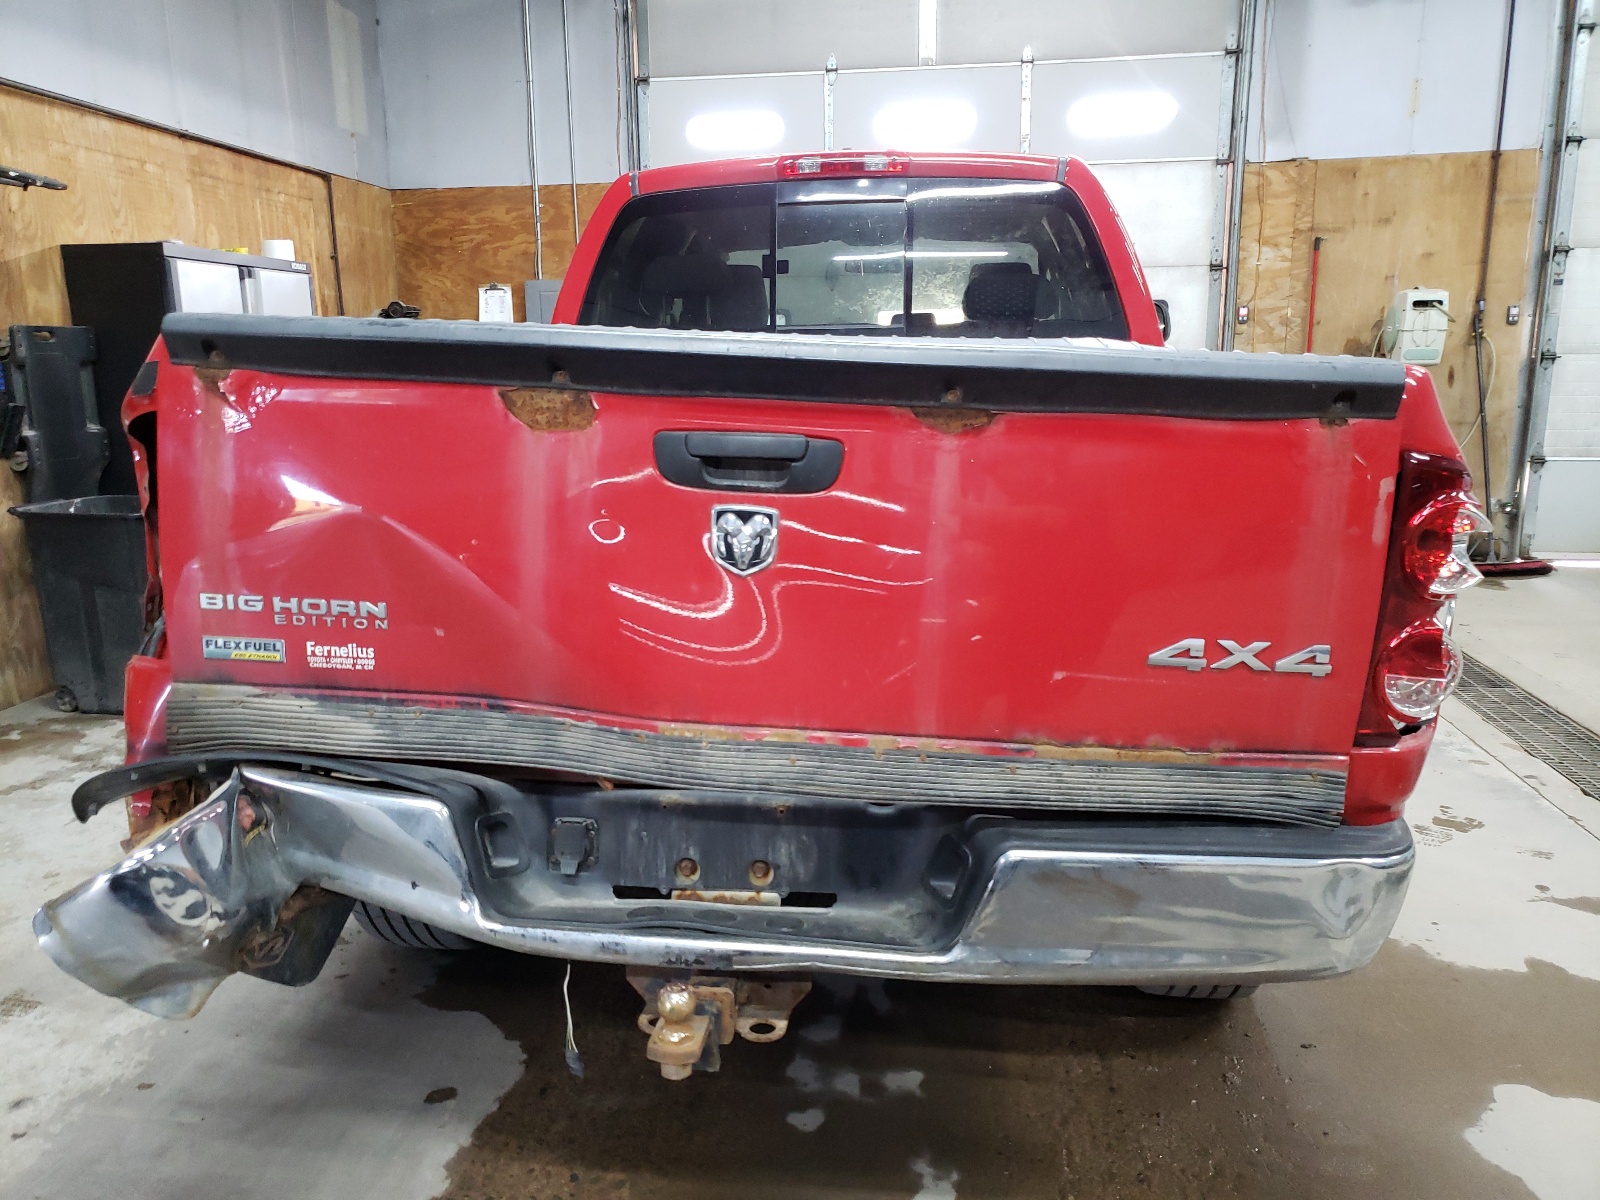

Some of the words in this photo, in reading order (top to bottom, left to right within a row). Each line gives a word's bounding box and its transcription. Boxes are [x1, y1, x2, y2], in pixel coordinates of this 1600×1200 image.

[199, 592, 264, 612] BIG
[272, 596, 388, 619] HORN
[274, 614, 389, 631] EDITION
[305, 641, 375, 659] Fernelius
[1147, 638, 1333, 677] 4X4
